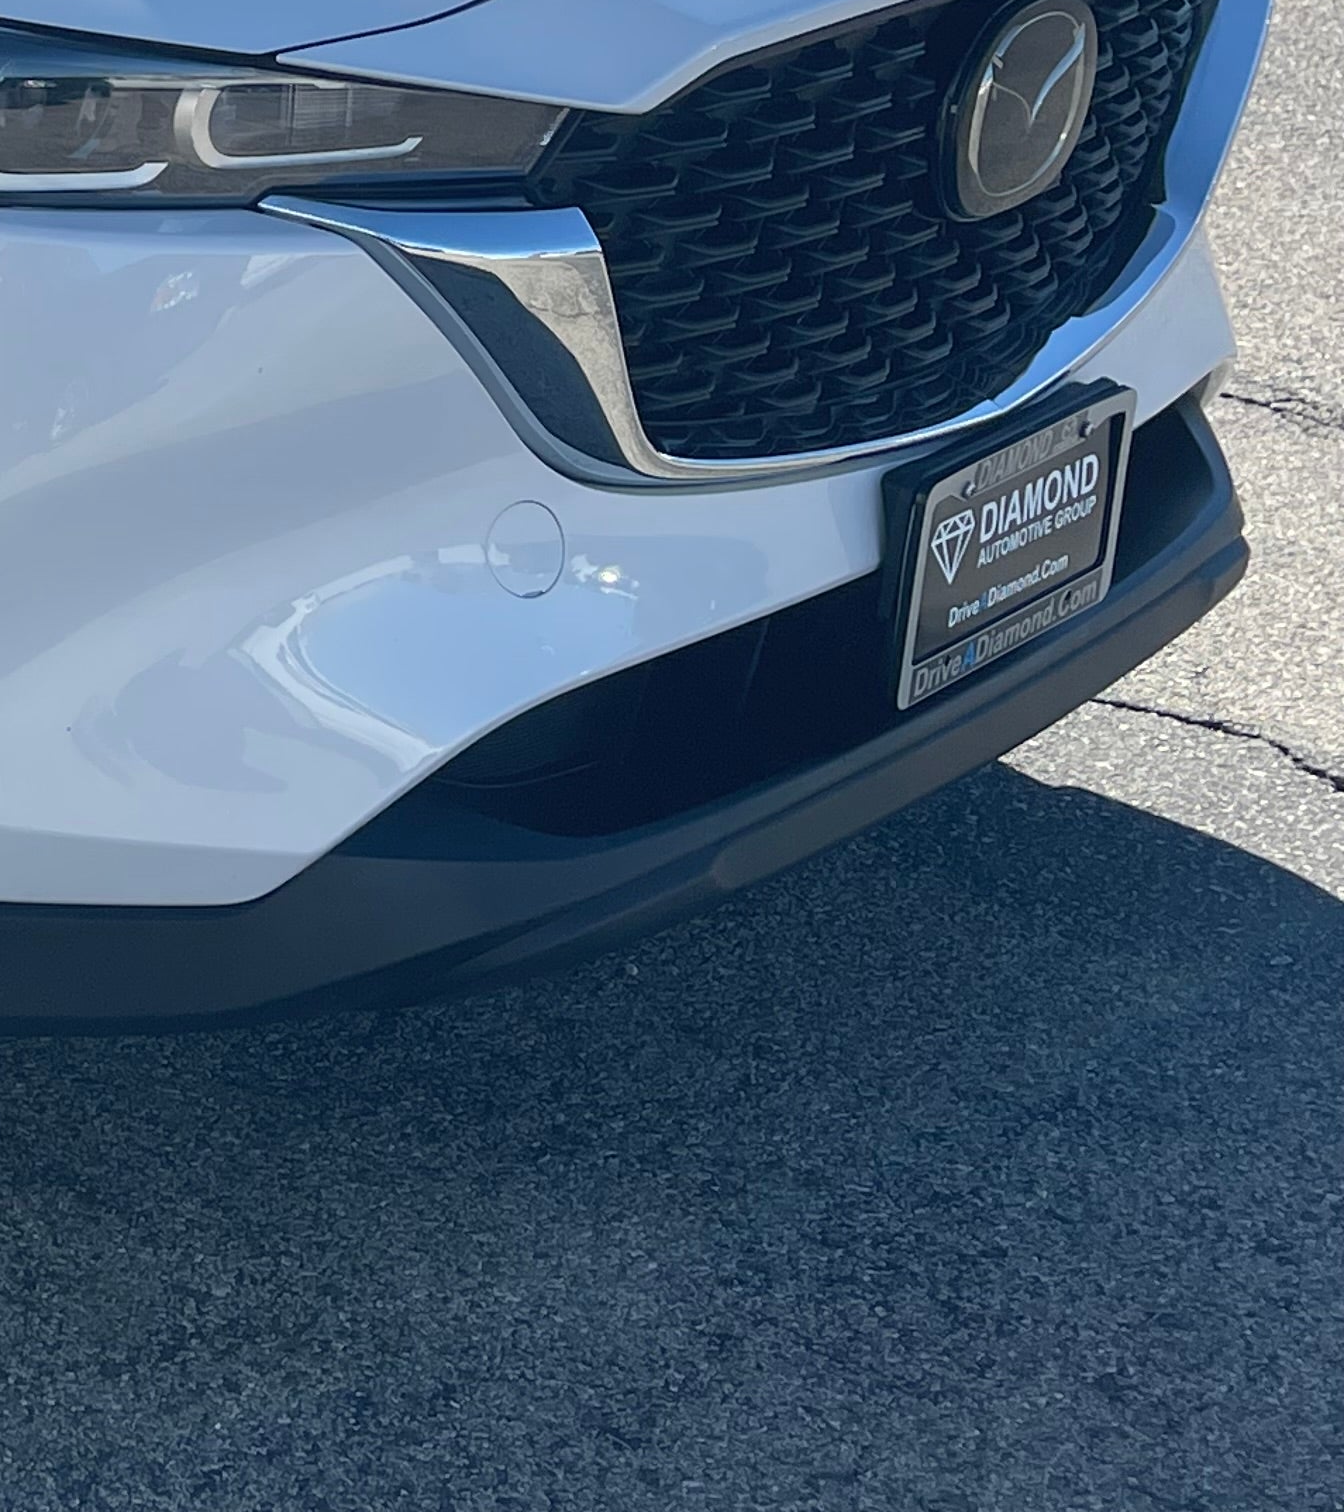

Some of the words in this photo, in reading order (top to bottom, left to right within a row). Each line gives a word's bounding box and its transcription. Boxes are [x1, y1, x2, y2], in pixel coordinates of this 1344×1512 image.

[977, 429, 1054, 489] DIAMOND
[976, 514, 1053, 569] AUTOMOTIVE
[1054, 494, 1098, 530] GROUP
[979, 454, 1100, 544] DIAMOND
[947, 554, 1070, 629] DriveADiamond.Com
[913, 580, 1099, 698] DriveADiamond.Com
